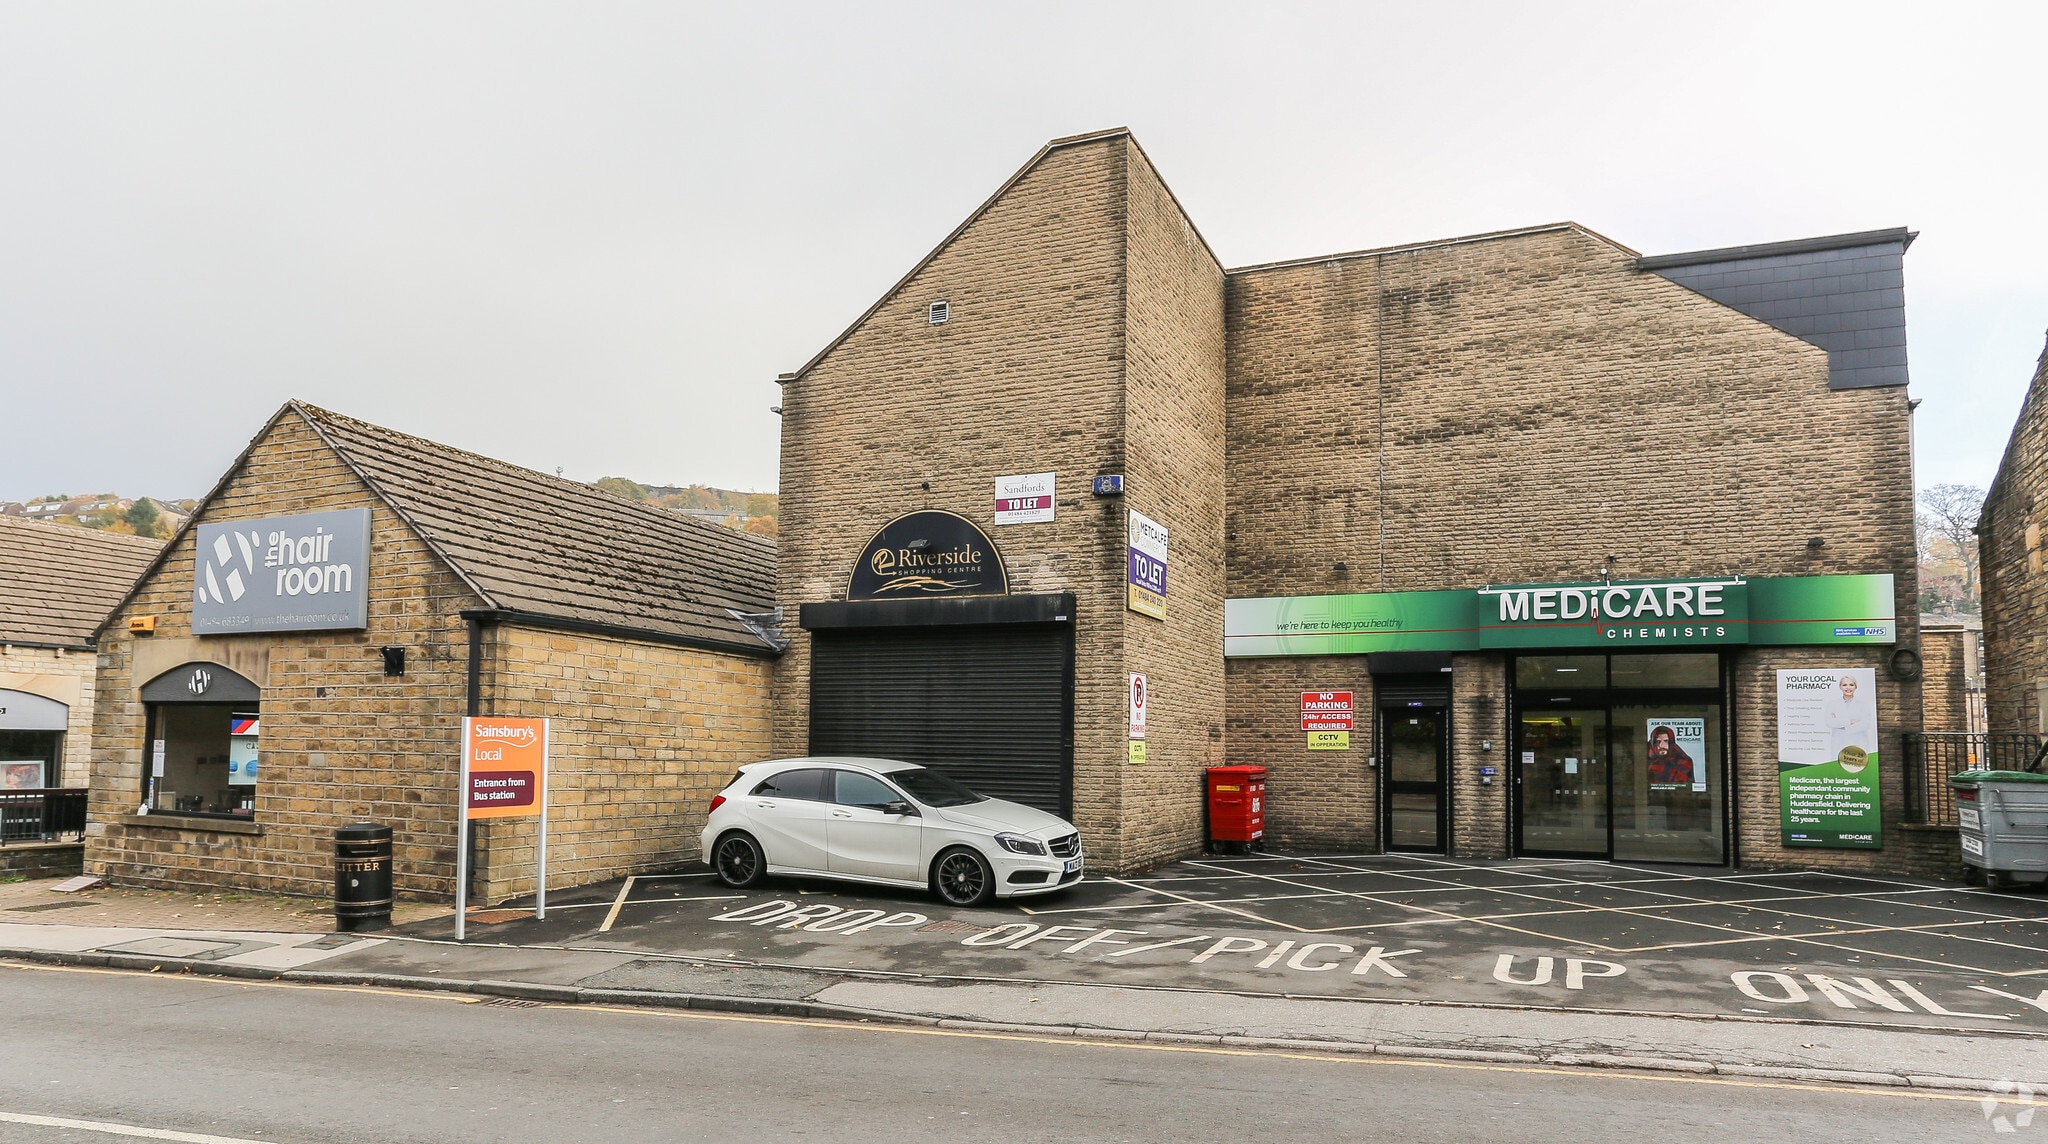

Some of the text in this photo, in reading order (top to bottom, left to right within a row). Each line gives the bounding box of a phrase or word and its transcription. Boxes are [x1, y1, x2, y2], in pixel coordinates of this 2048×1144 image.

[1003, 483, 1045, 494] Sandfords
[1008, 497, 1039, 510] TO LET
[1139, 522, 1167, 547] METCALFE
[264, 531, 279, 568] the
[278, 527, 333, 566] hair
[898, 544, 982, 567] Riverside
[898, 568, 943, 576] SHOPPING
[1134, 553, 1147, 579] TO
[1149, 560, 1163, 586] LET
[276, 563, 351, 596] room
[1276, 618, 1403, 630] we're here to keep you healthy
[1607, 626, 1725, 638] CHEMISTS
[475, 724, 534, 740] Sainsbury's
[1676, 727, 1702, 737] FLU
[475, 747, 502, 760] Local
[474, 778, 525, 788] Entrance from
[1835, 777, 1859, 785] largest
[474, 791, 515, 800] Bus station
[1836, 801, 1871, 809] Delivering
[708, 899, 928, 936] DROP
[1493, 953, 1628, 990] UP
